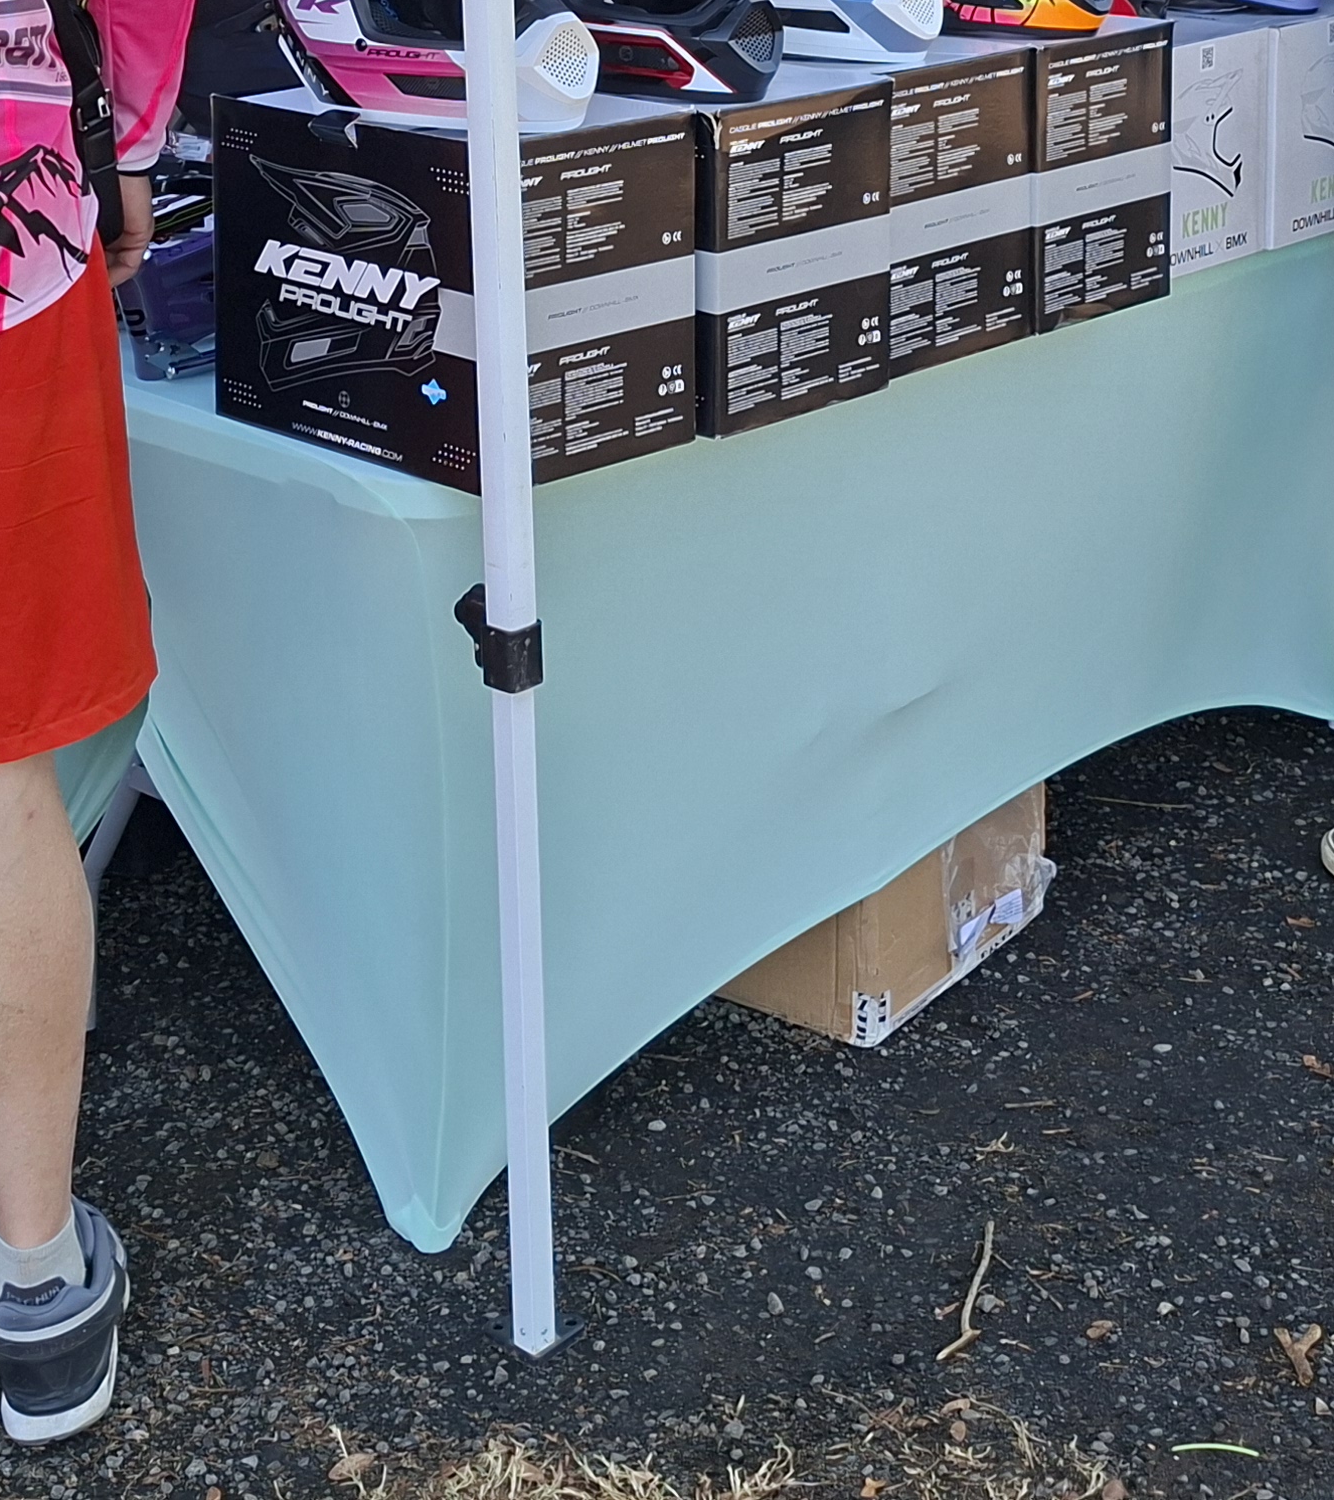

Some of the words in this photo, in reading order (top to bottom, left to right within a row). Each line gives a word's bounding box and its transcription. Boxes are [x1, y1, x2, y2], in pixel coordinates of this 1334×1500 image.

[1182, 202, 1228, 239] KENNY
[1226, 232, 1247, 250] BMX
[254, 239, 441, 310] KENNY
[292, 422, 403, 462] WWW.KENNY-RACING.COM
